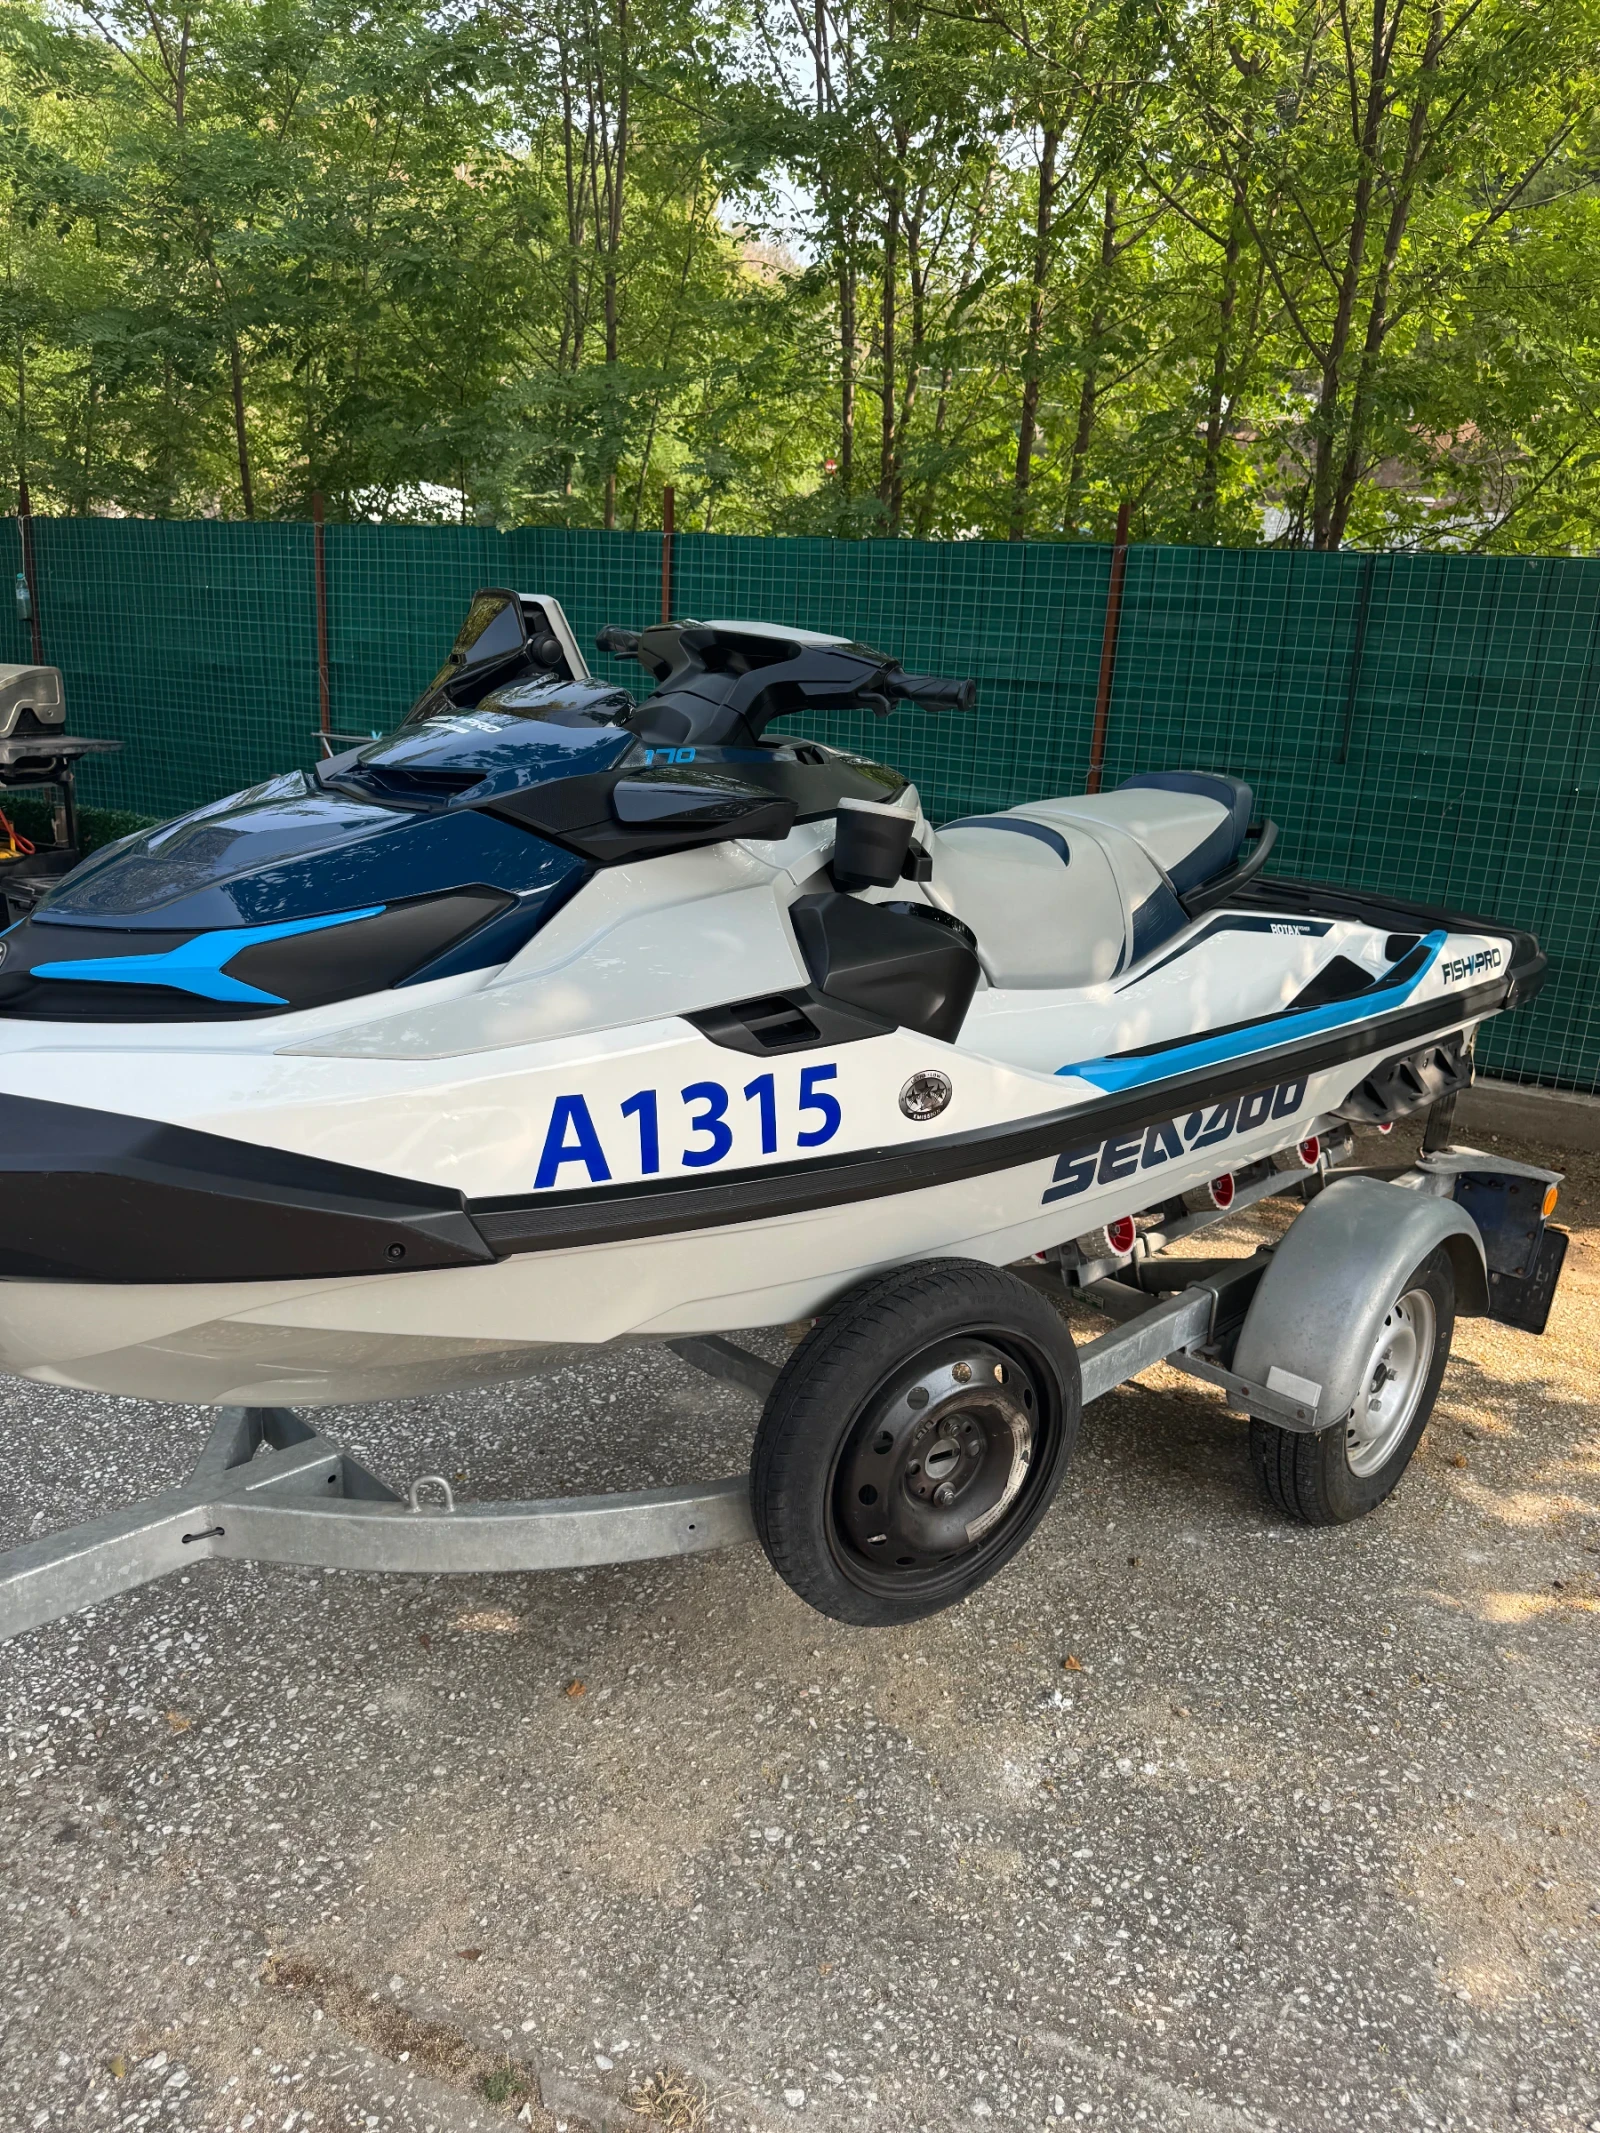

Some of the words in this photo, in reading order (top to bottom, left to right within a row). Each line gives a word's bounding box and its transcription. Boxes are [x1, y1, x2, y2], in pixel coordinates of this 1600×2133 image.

[645, 747, 696, 766] 170
[1270, 923, 1301, 936] ROTAX
[533, 1062, 842, 1190] A1315
